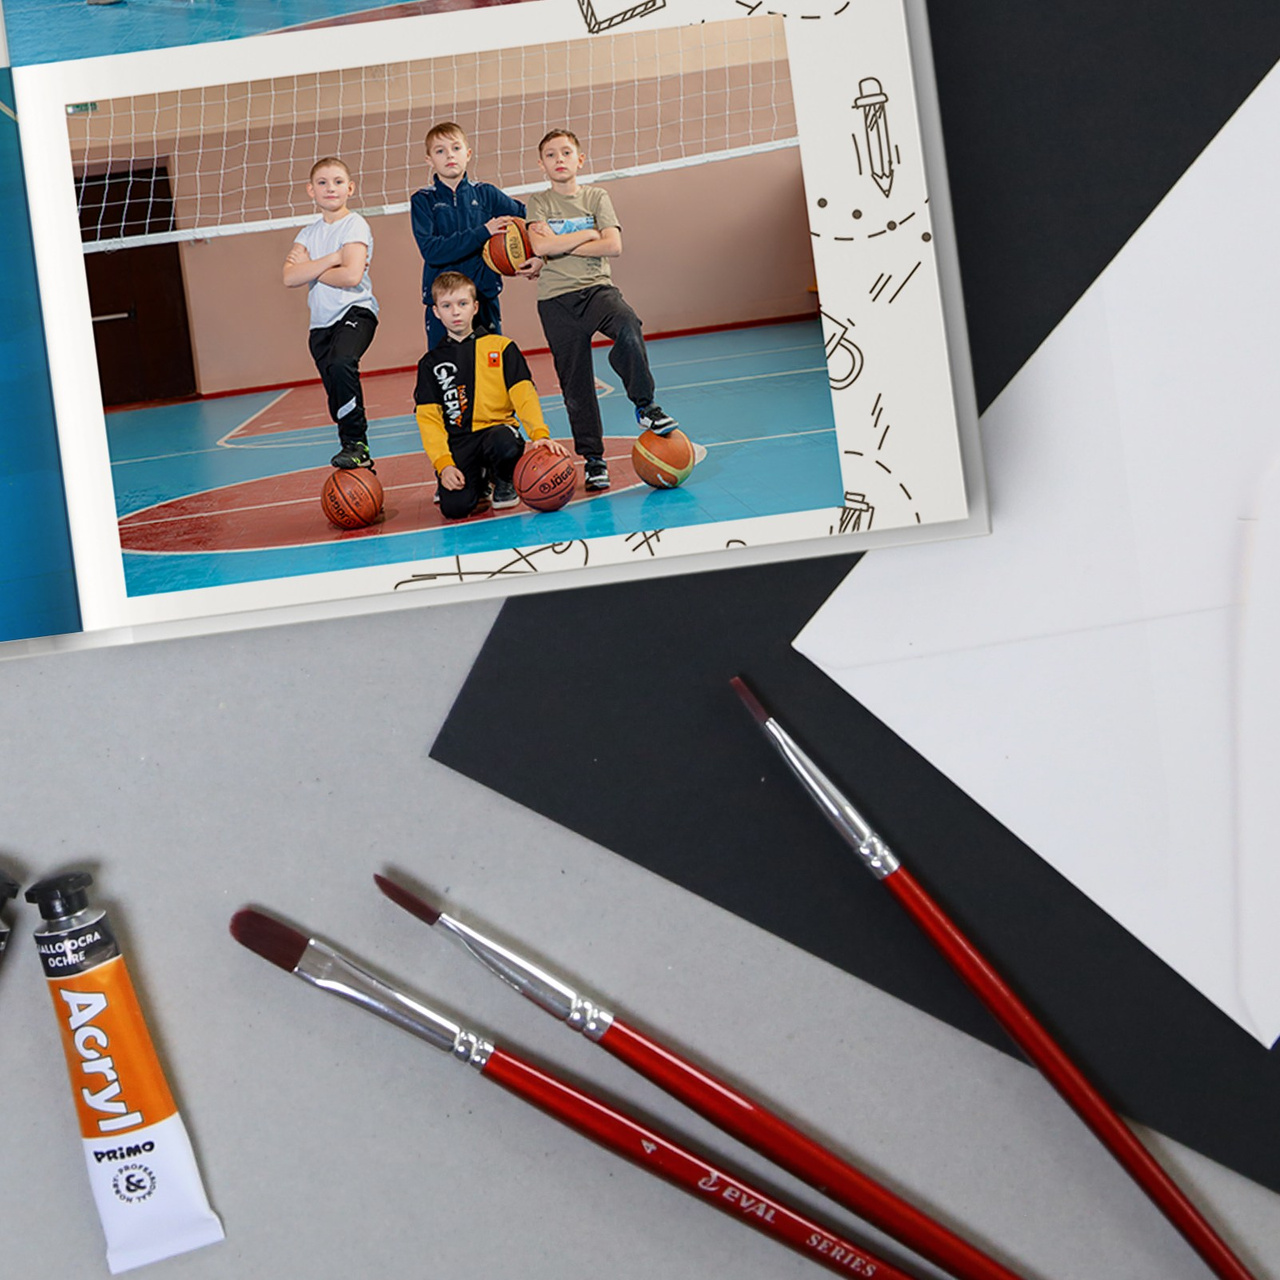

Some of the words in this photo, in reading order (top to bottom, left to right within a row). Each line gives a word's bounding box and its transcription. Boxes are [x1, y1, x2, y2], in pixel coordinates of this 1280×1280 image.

[67, 931, 101, 951] OCRA
[47, 951, 86, 968] OCHRE
[60, 987, 144, 1134] Acryl
[806, 1232, 877, 1278] SERIES
